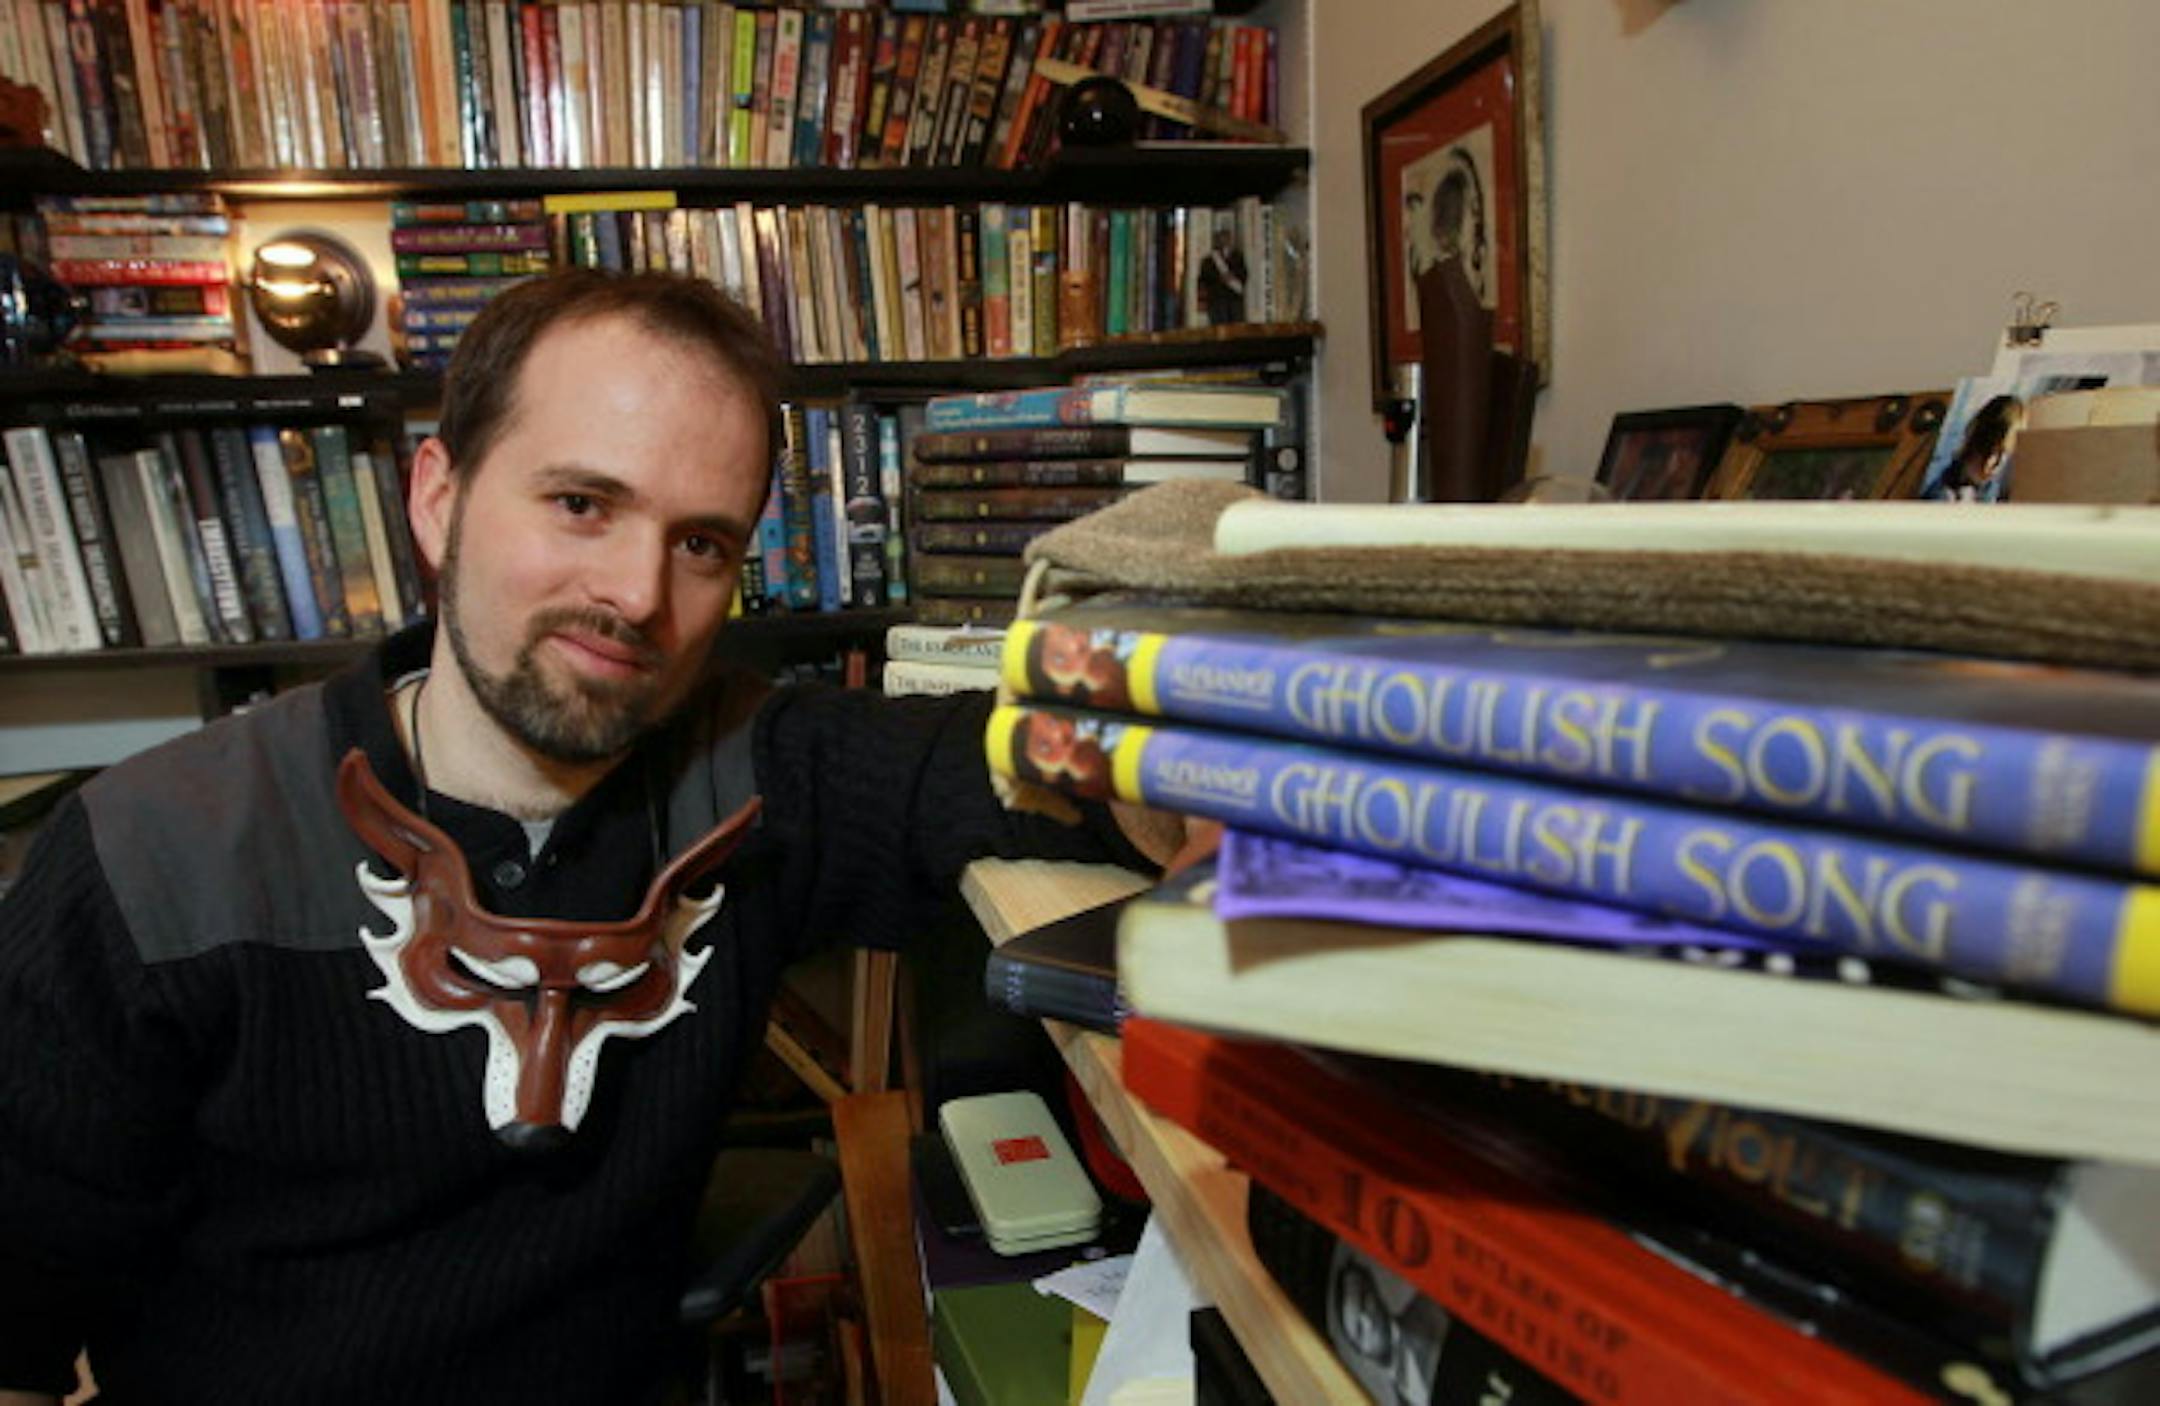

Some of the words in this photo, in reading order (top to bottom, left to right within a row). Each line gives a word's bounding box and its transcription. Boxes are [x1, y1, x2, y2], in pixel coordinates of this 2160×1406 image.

[852, 414, 869, 495] 2312
[1286, 660, 1661, 783] GHOULISH
[1693, 708, 1983, 831] SONG
[1270, 760, 1644, 897] GHOULISH
[1675, 830, 1960, 961] SONG
[1342, 1170, 1433, 1269] 10
[1572, 1305, 1632, 1355] OF
